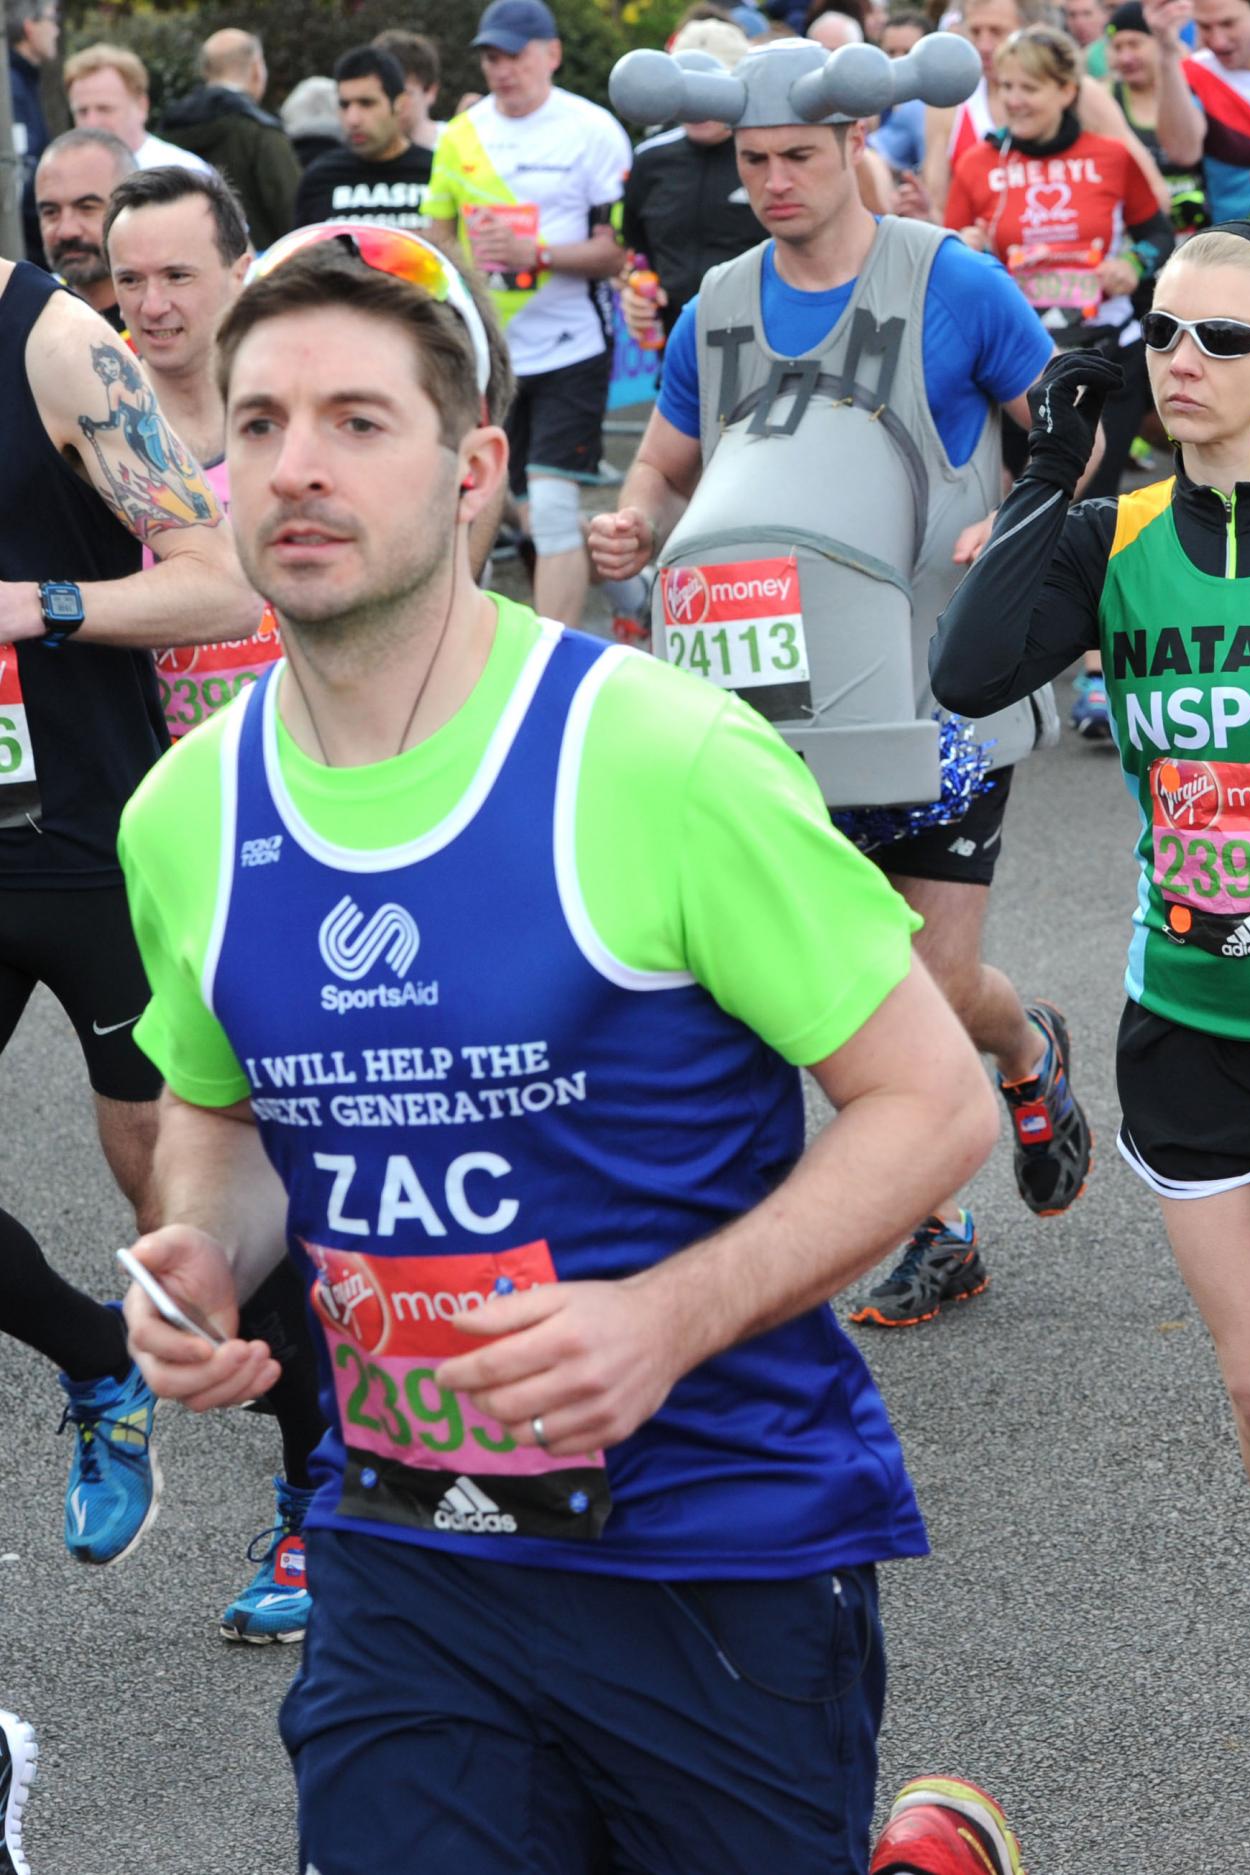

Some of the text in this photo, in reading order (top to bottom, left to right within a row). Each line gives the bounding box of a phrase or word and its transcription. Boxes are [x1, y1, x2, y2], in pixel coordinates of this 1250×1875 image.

[988, 159, 1102, 192] CHERYL
[707, 308, 906, 436] TOM
[711, 577, 791, 602] money
[670, 622, 800, 677] 24113
[321, 981, 438, 1014] SportsAid
[246, 1041, 550, 1088] I WILL HELP THE
[250, 1072, 587, 1126] NEXT GENERATION
[313, 1151, 519, 1236] ZAC
[433, 1508, 518, 1533] adidas
